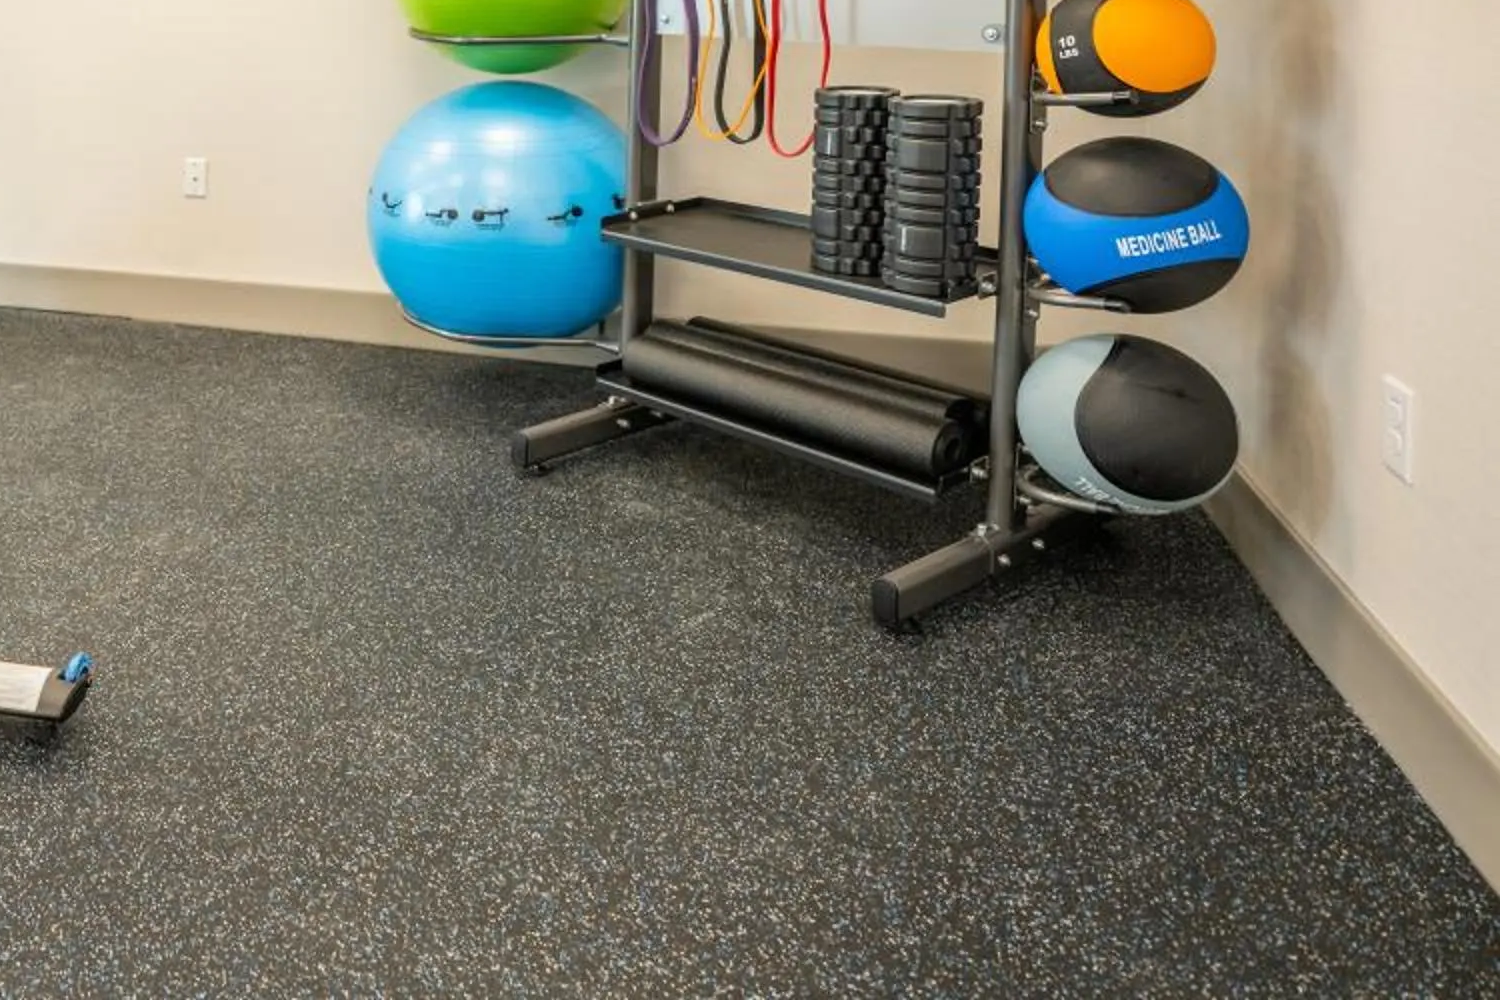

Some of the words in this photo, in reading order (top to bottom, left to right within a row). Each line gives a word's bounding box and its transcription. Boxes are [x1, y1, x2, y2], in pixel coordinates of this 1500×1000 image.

[1059, 34, 1076, 49] 10
[1059, 47, 1080, 59] LBS
[1115, 227, 1189, 258] MEDICINE
[1187, 219, 1222, 246] BALL
